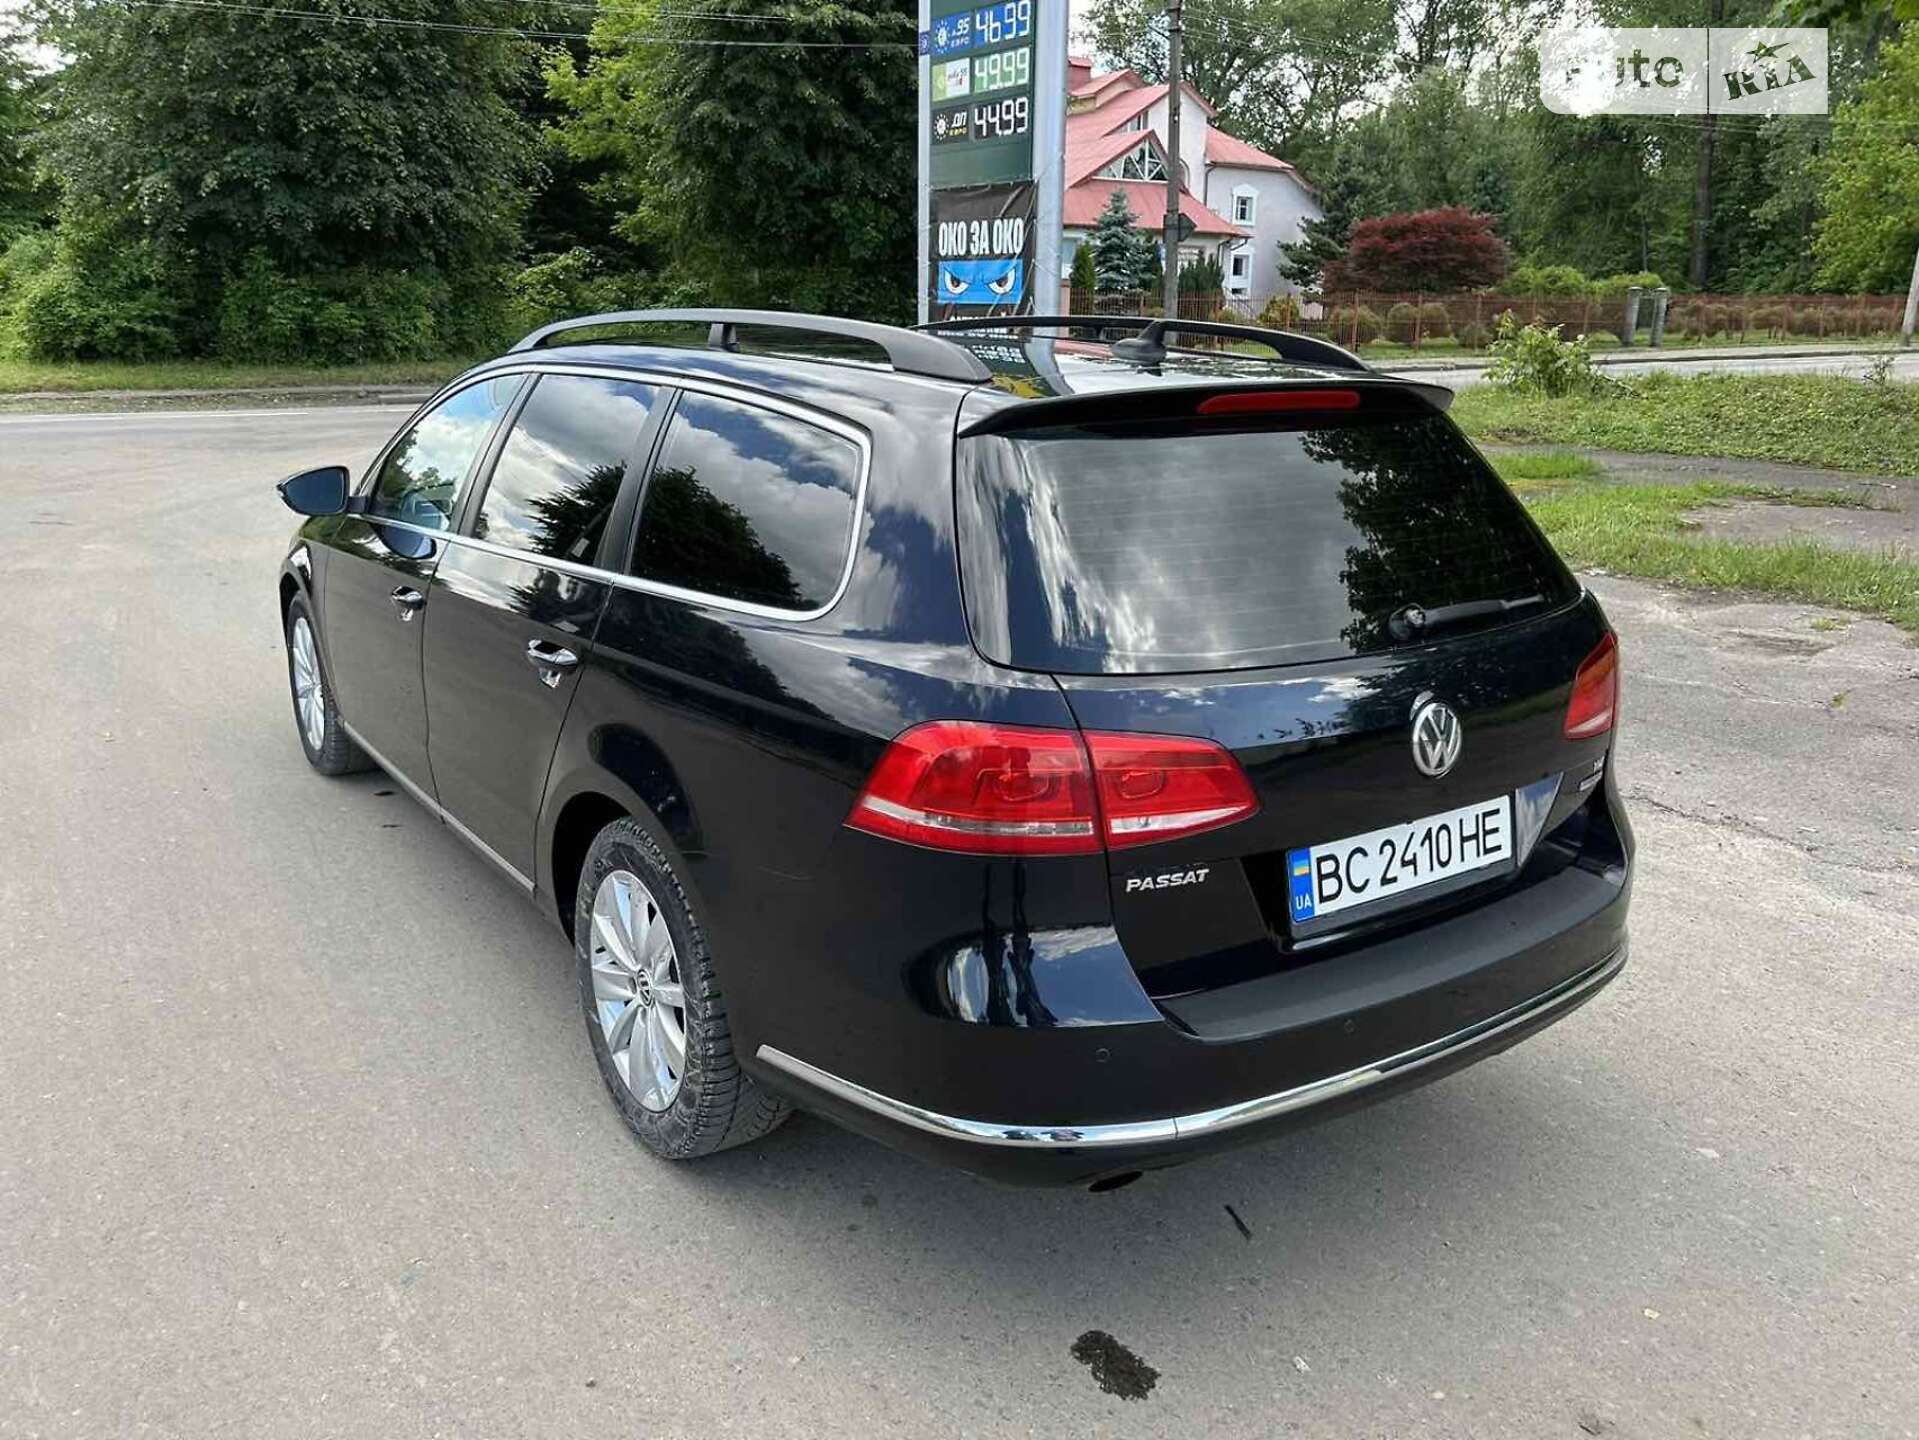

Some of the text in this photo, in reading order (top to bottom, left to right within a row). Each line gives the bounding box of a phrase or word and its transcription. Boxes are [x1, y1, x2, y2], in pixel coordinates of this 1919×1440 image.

[938, 217, 1024, 256] ОКО ЗА ОКО
[1379, 823, 1452, 887] 2410
[1125, 868, 1210, 893] PASSAT
[1295, 895, 1312, 911] UA
